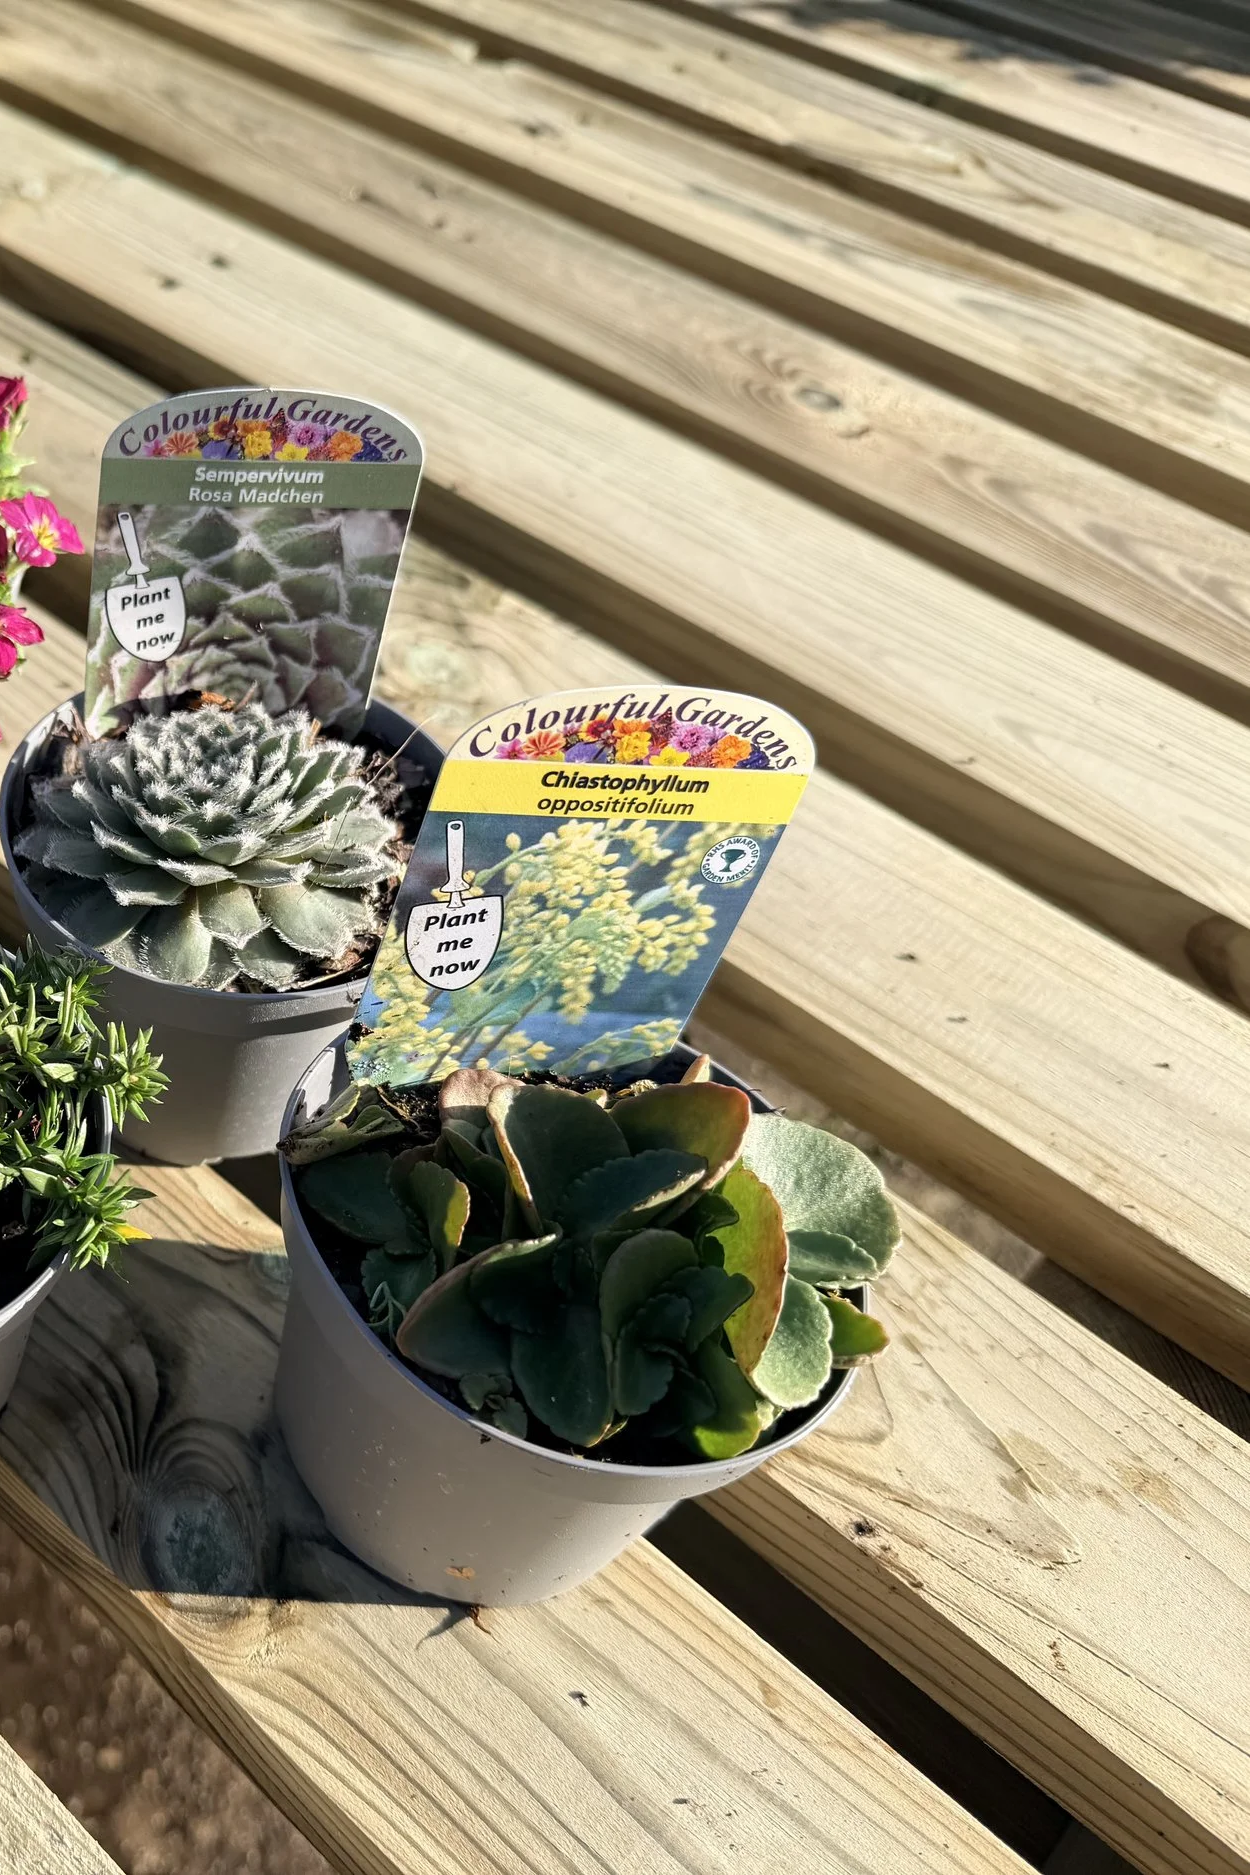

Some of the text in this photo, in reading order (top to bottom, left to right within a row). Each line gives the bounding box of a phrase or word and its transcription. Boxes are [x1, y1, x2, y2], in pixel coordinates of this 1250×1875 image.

[119, 397, 407, 462] Colourful Gardens
[195, 467, 324, 487] Sempervivum
[189, 487, 323, 504] Rosa Madchen
[121, 587, 171, 611] Plant
[136, 612, 165, 629] me
[136, 631, 175, 650] now
[469, 693, 797, 770] Colourful Gardens
[541, 771, 710, 794] Chiastophyllum
[537, 797, 694, 816] oppositifolium
[708, 843, 724, 857] RHS
[726, 838, 756, 849] AWARD
[703, 863, 752, 882] GARDEN MERIT
[424, 908, 488, 931] Plant
[436, 937, 473, 953] me
[429, 958, 480, 977] now
